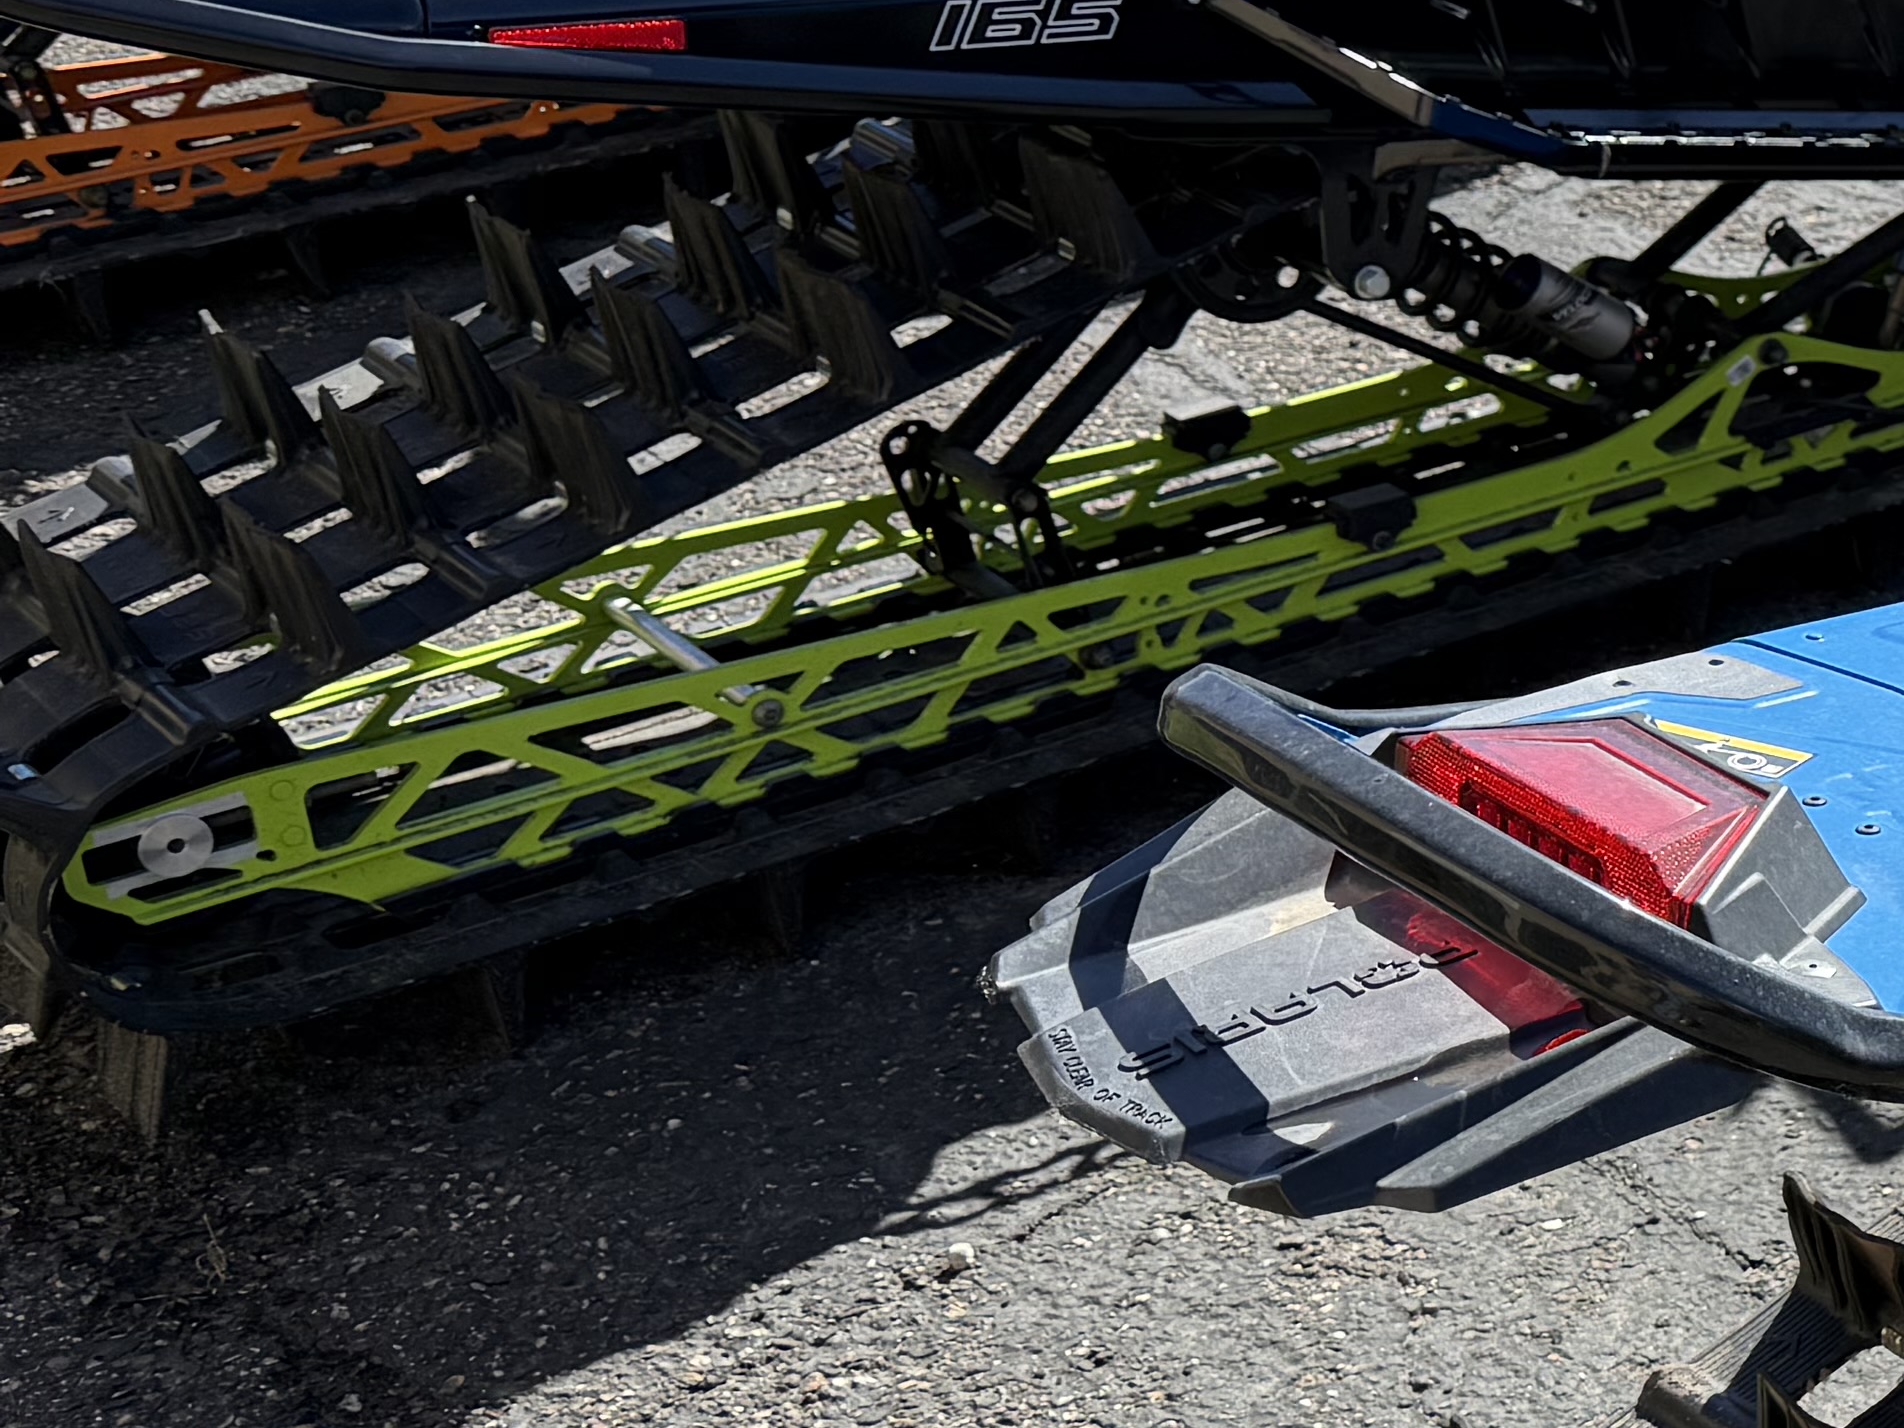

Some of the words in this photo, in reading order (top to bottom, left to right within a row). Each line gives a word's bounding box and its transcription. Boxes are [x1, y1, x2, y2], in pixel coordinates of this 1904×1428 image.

[1116, 940, 1479, 1081] POLARIS
[1048, 1028, 1077, 1053] STAY
[1062, 1055, 1095, 1091] CLEAR
[1093, 1088, 1122, 1103] OF
[1119, 1098, 1174, 1130] TRACK
